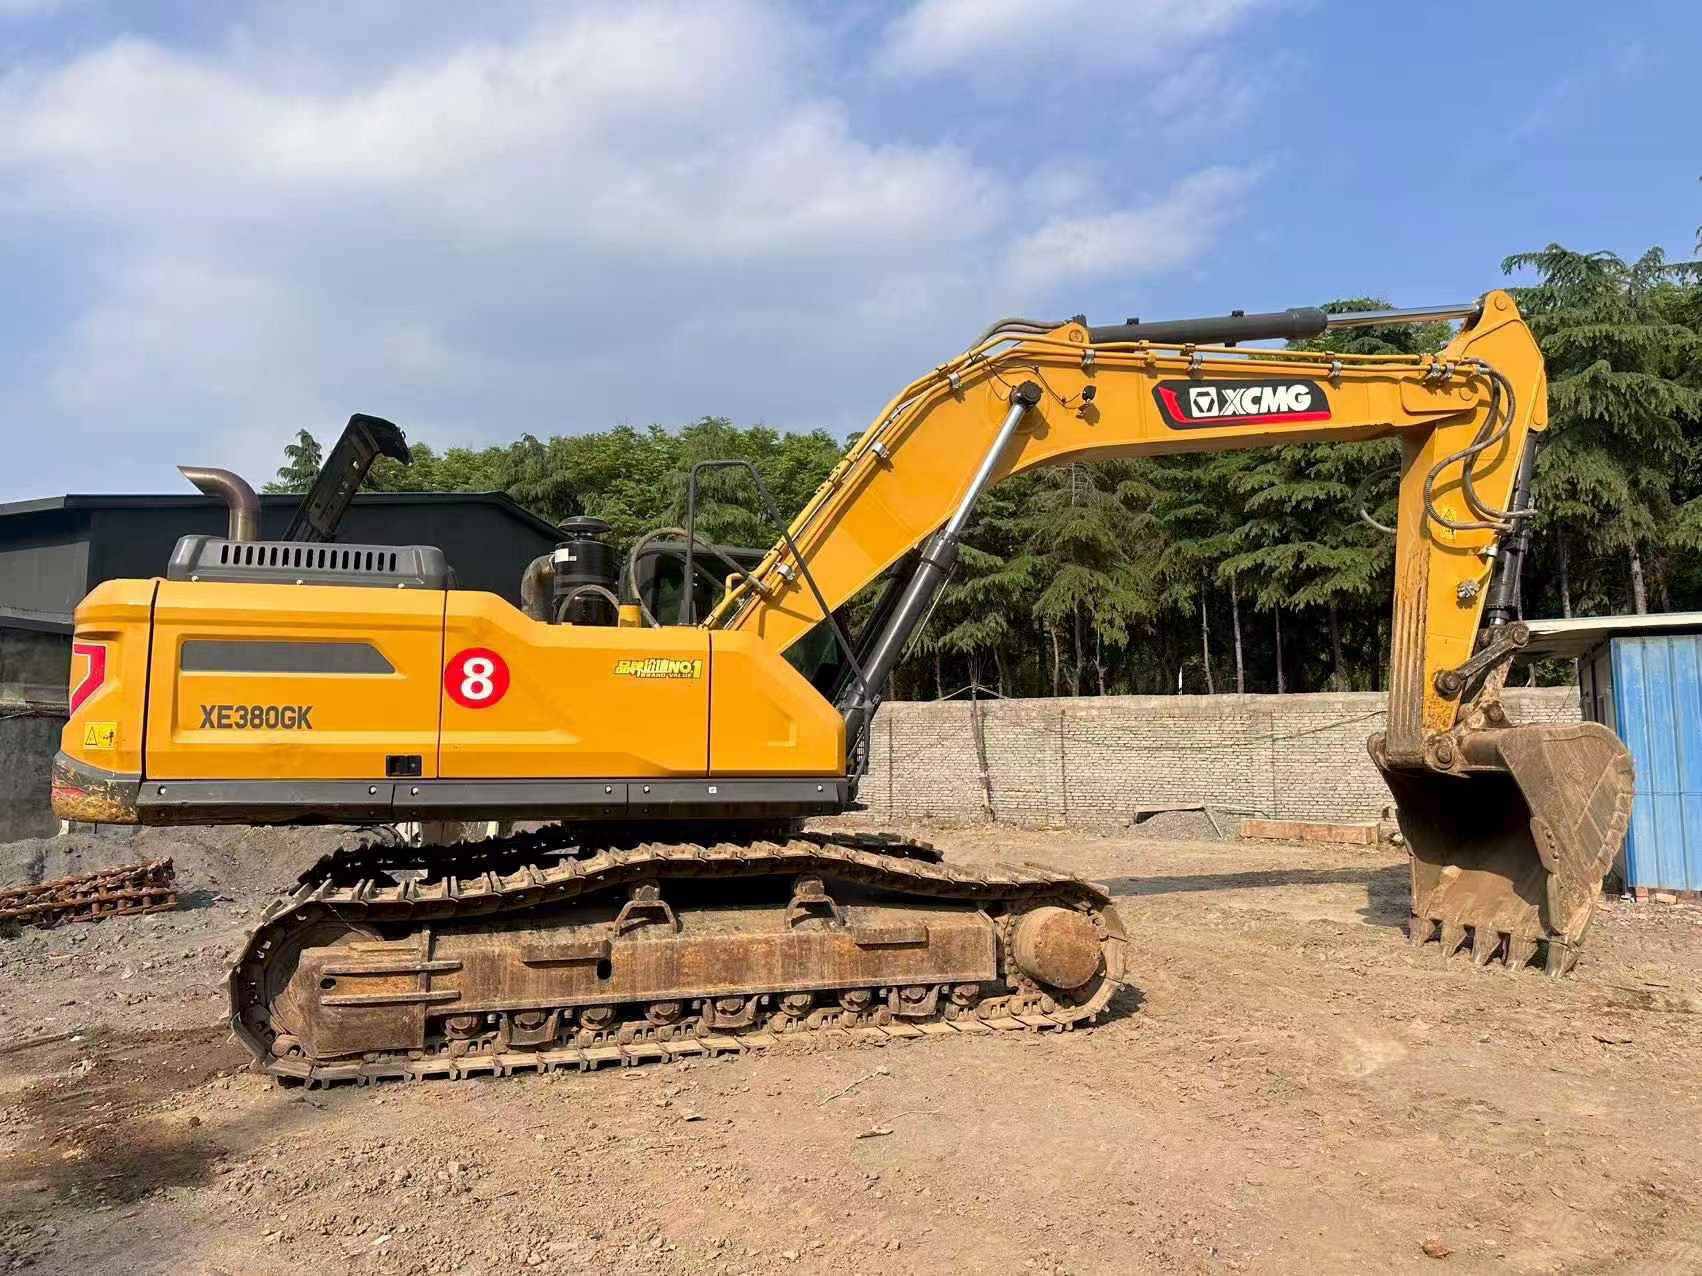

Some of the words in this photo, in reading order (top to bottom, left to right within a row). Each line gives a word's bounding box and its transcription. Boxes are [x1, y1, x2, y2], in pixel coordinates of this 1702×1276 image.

[1220, 384, 1311, 415] XCMG
[461, 657, 494, 700] 8
[200, 704, 312, 729] XE380GK
